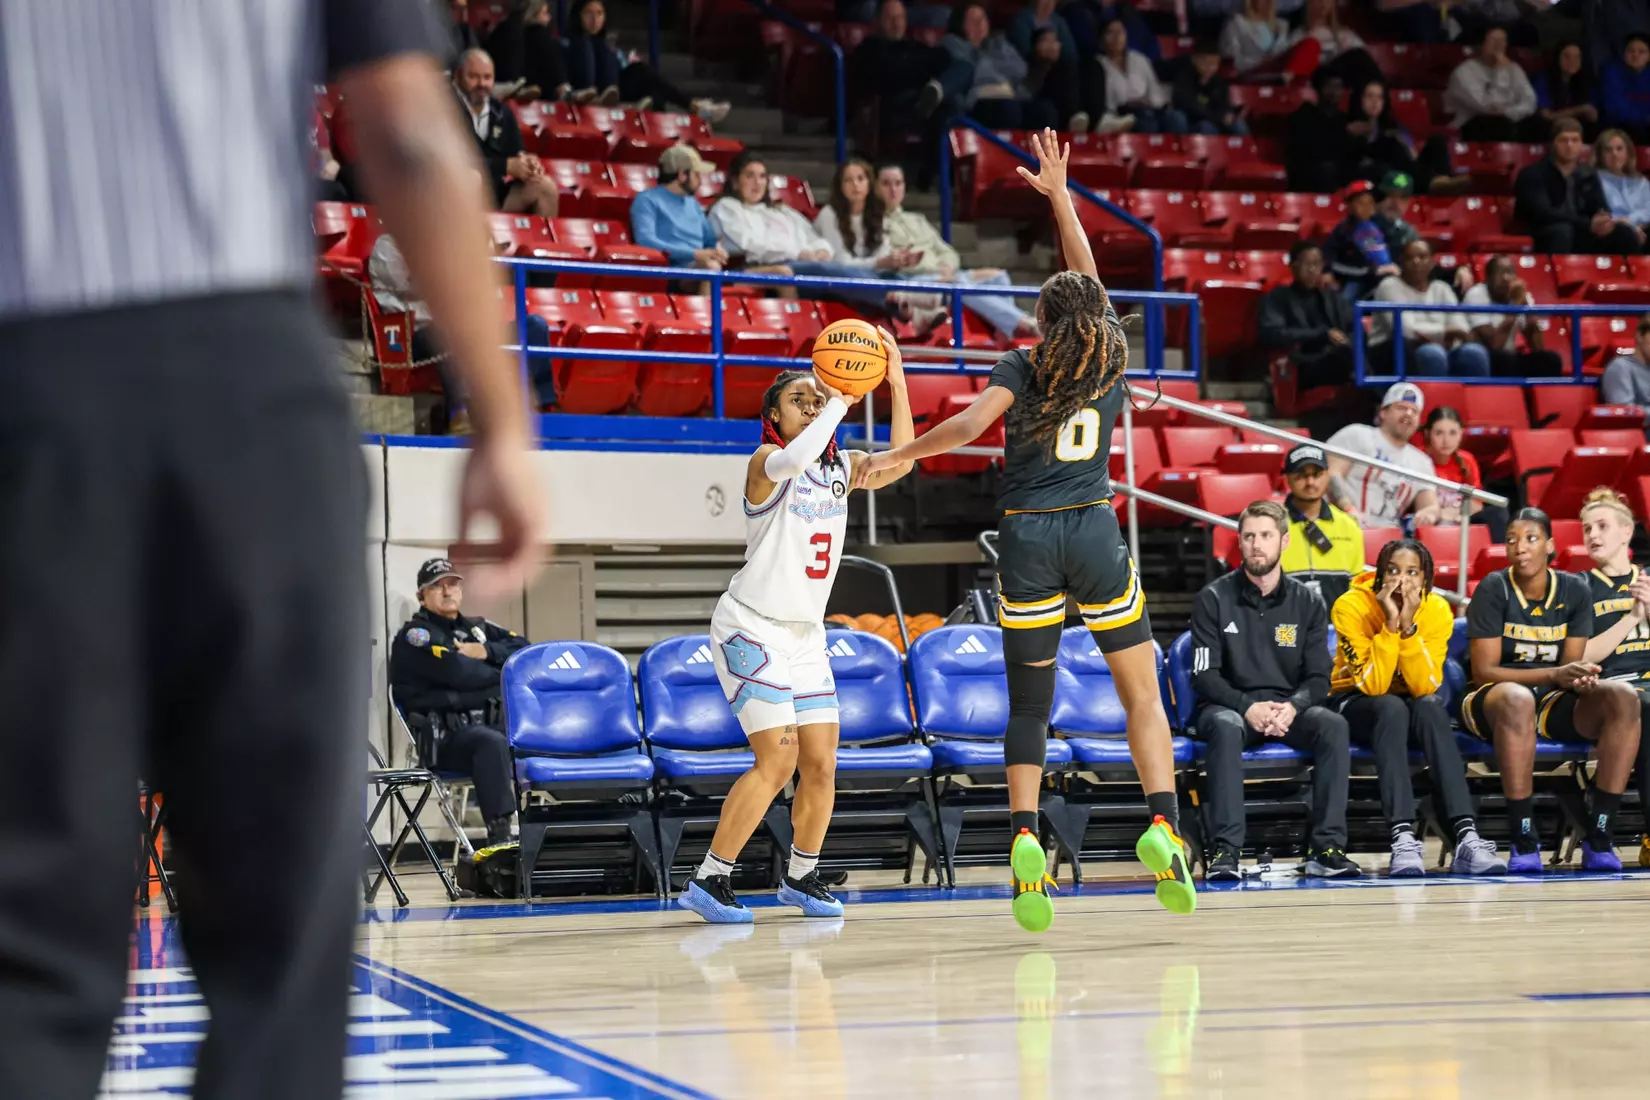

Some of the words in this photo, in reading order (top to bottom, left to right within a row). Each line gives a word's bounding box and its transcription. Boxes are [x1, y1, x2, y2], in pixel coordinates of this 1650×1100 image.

[384, 325, 401, 346] T
[828, 332, 879, 351] Wilson
[1055, 407, 1101, 462] 0
[805, 532, 831, 579] 3
